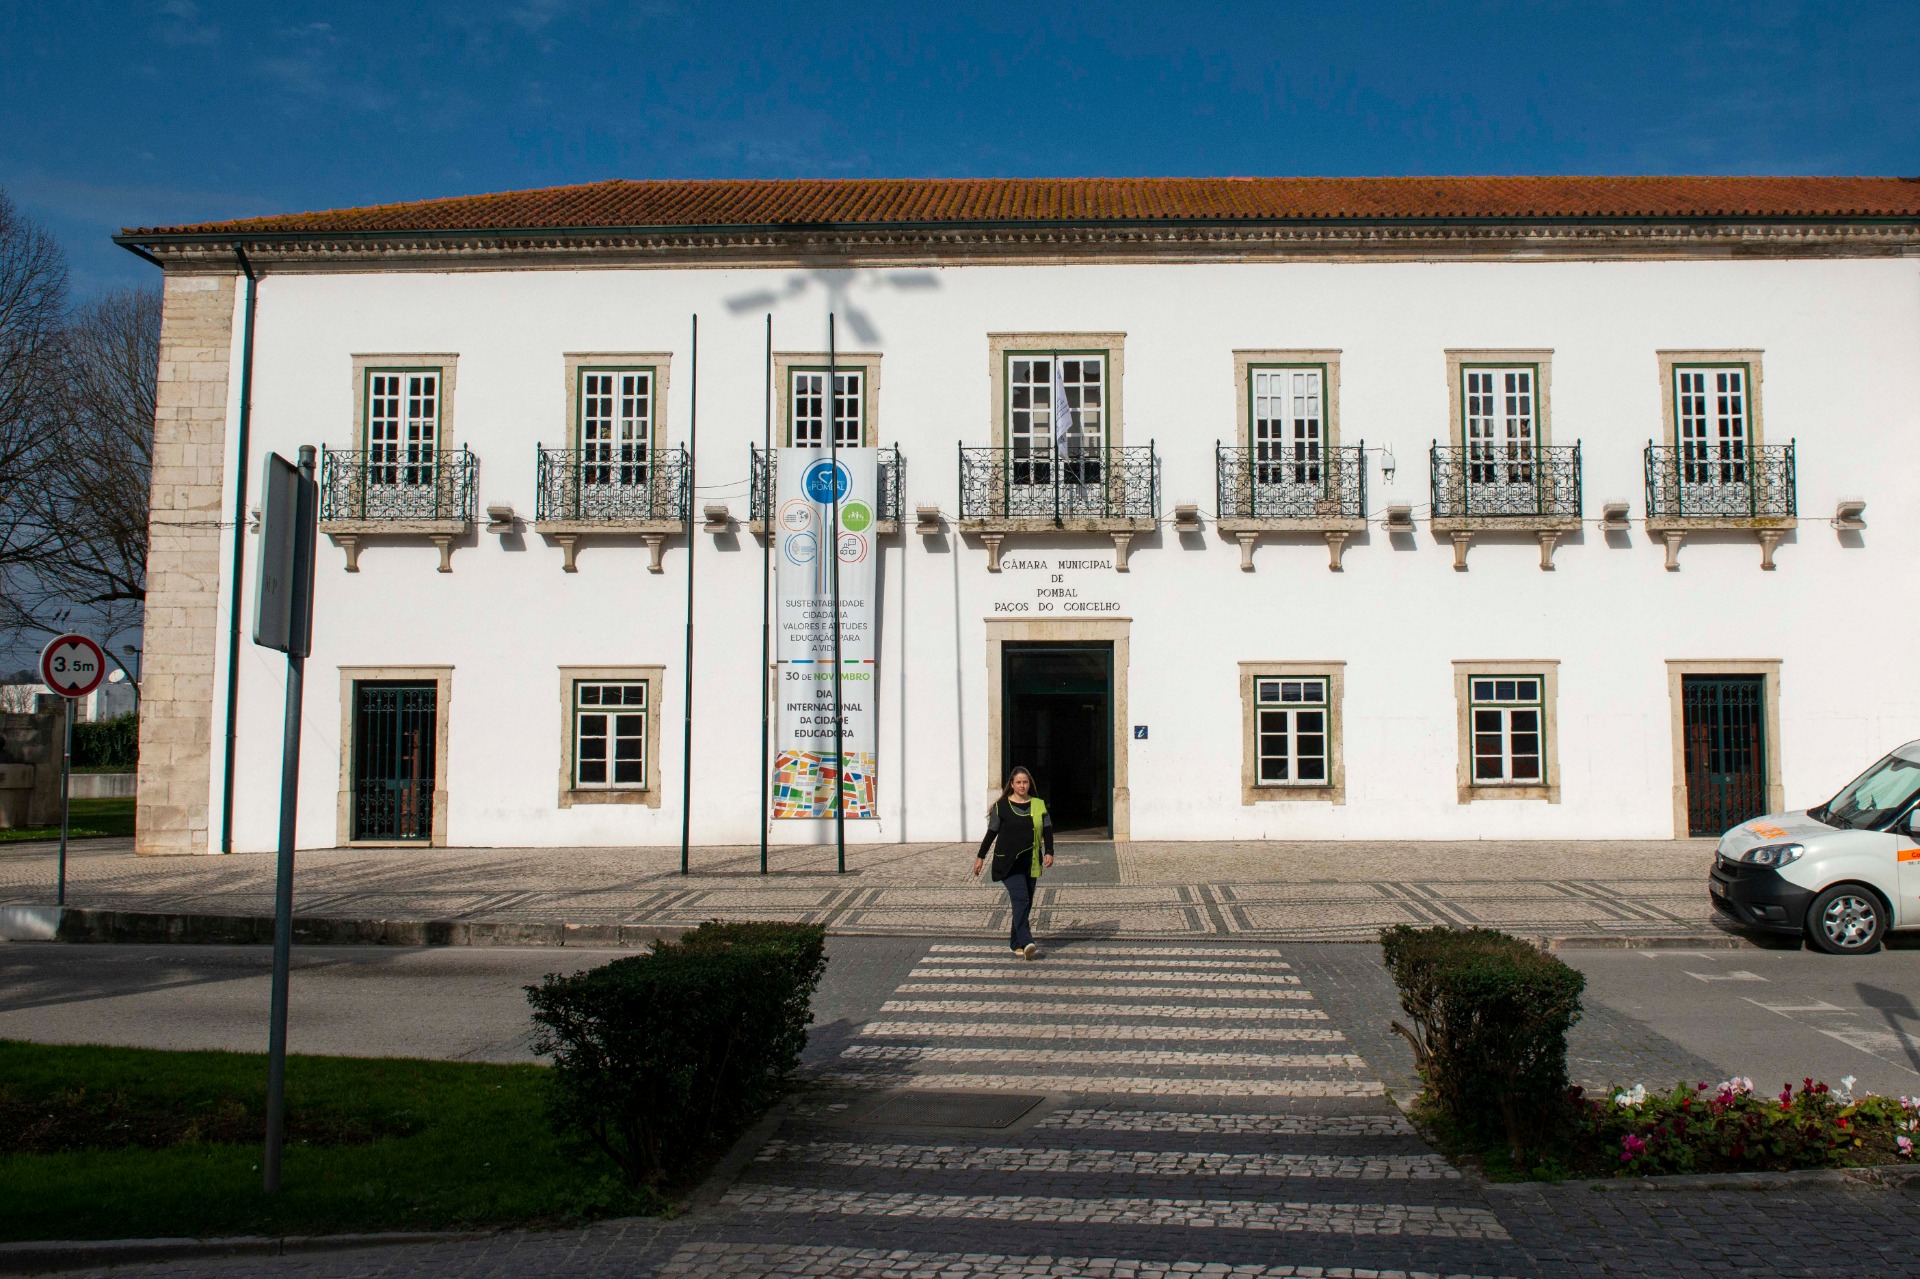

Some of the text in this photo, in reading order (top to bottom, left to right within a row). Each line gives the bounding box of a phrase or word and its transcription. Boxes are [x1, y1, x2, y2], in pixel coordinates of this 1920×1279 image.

[1002, 559, 1112, 570] CÂMARA MUNICIPAL
[1052, 574, 1064, 582] DE
[1037, 588, 1078, 598] POMBAL
[994, 602, 1120, 612] PAÇOS DO CONCELHO
[786, 672, 799, 680] 30
[816, 690, 832, 698] DIA
[787, 703, 862, 711] INTERNACINAL
[814, 716, 849, 724] CIDAE
